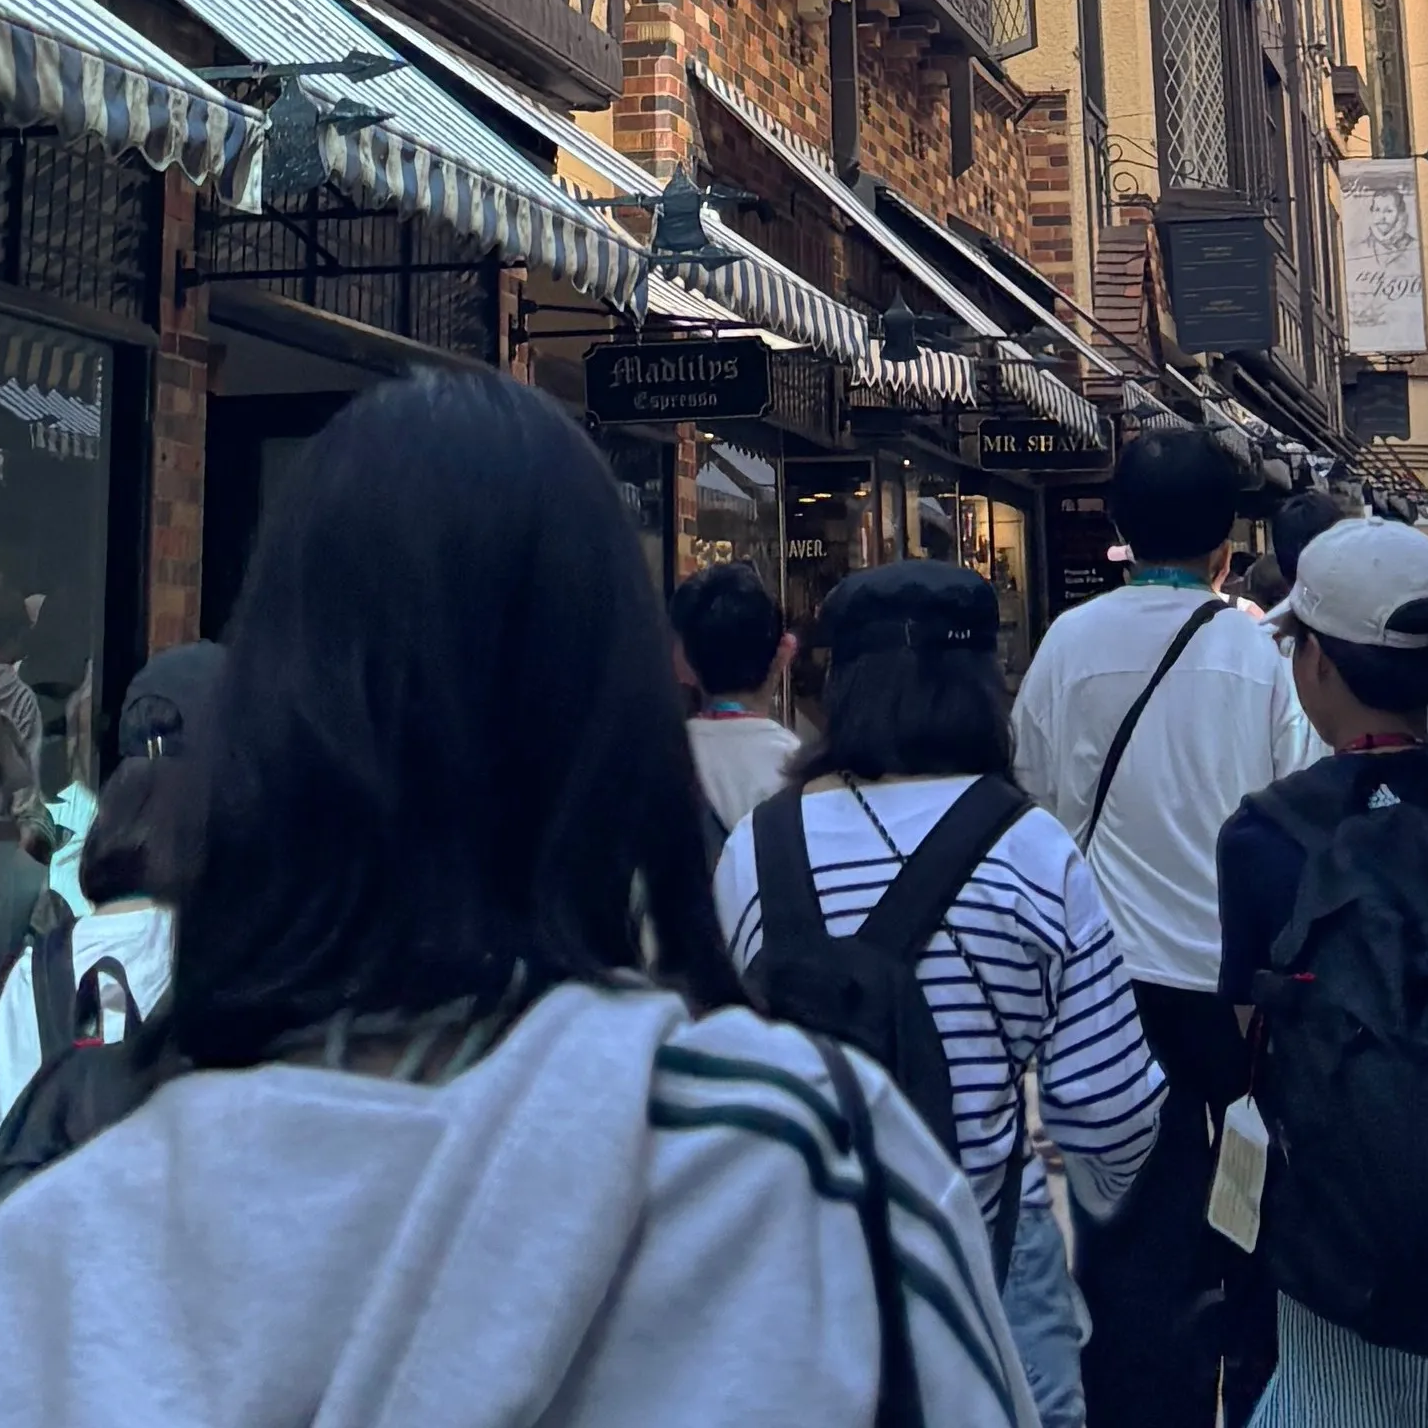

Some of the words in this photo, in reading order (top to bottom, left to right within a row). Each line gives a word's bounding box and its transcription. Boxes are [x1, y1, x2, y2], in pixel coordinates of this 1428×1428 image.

[610, 352, 740, 389] Madlilys
[633, 389, 718, 412] Espresso
[982, 434, 1023, 453] MR.
